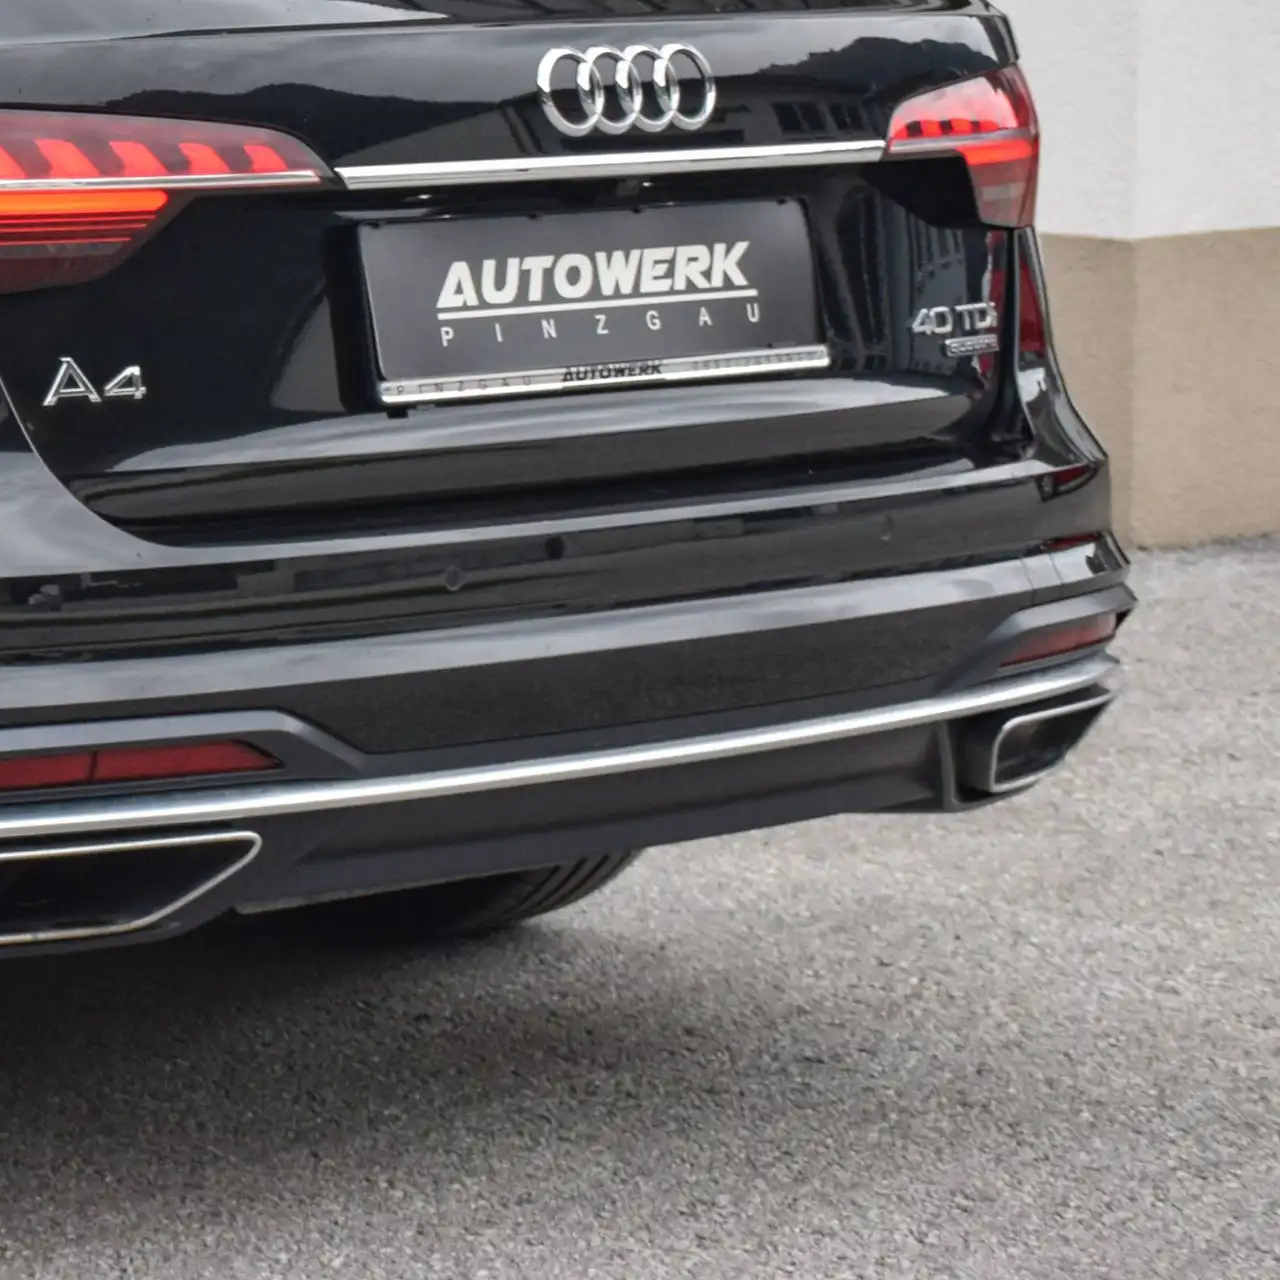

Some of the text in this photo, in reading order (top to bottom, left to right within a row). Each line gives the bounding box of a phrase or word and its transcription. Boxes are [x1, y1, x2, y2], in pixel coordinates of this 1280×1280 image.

[436, 240, 750, 309] AUTOWERK
[440, 302, 761, 347] PINZGAU
[911, 306, 953, 335] 40
[42, 356, 147, 407] A4
[561, 361, 663, 384] AUTOWERK
